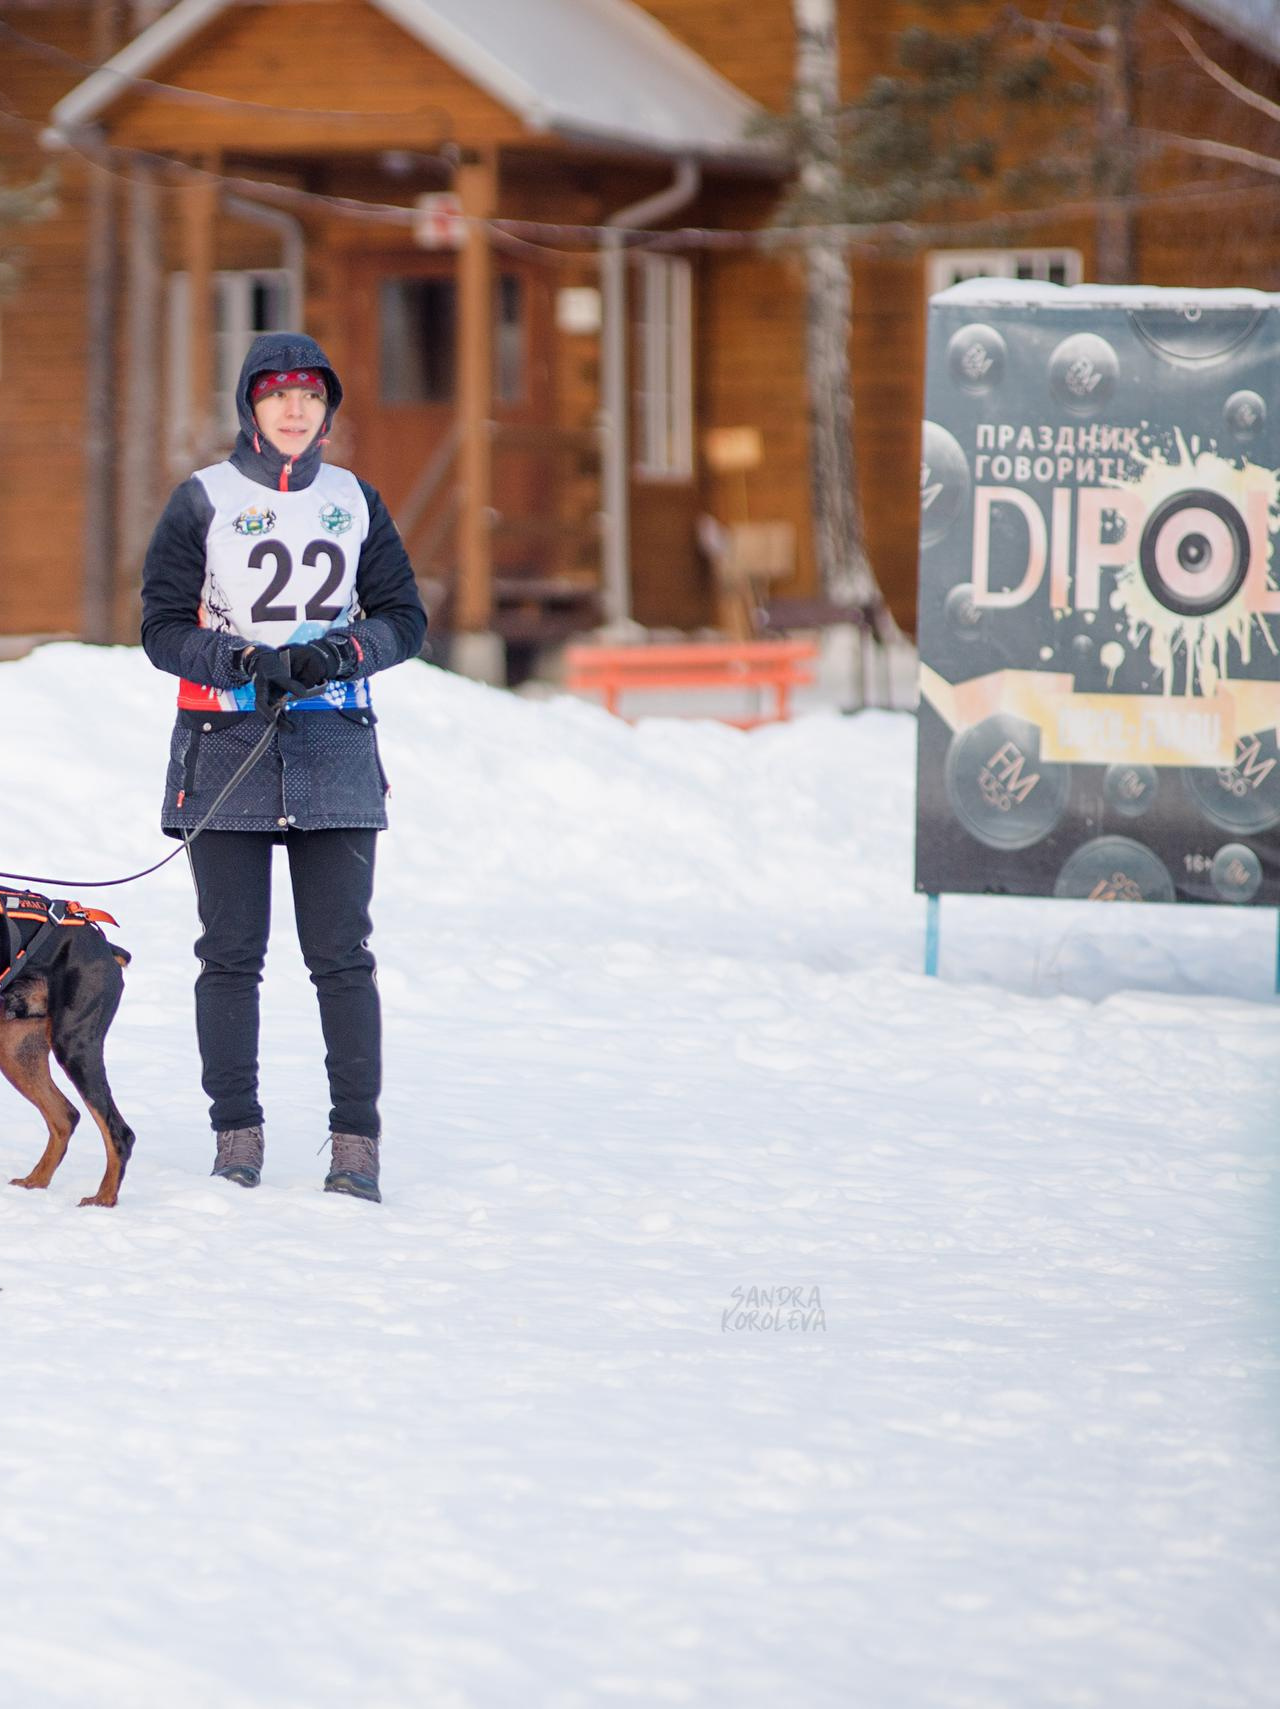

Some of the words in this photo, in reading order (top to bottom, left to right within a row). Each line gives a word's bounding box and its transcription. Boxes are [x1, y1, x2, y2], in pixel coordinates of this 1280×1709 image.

[976, 423, 1140, 456] ПРАЗДНИК
[248, 538, 347, 624] 22
[972, 485, 1280, 616] DIPOL
